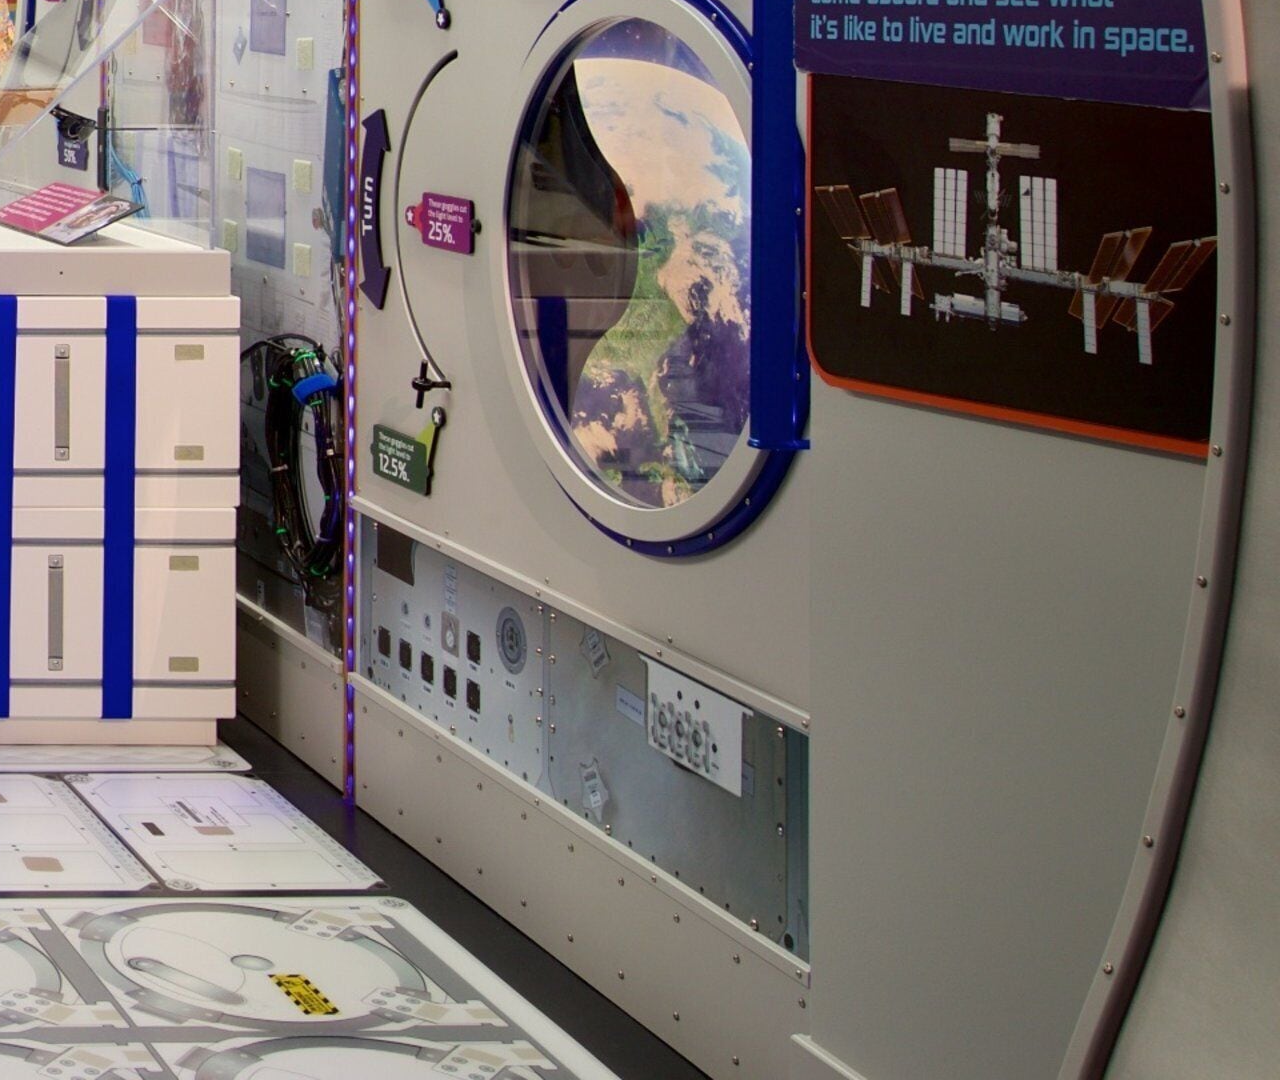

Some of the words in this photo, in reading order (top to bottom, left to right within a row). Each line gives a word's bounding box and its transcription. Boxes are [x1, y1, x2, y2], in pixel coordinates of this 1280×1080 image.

[843, 15, 877, 41] like
[883, 16, 903, 42] to
[909, 16, 947, 44] live
[953, 18, 996, 45] and
[1003, 19, 1065, 49] work
[1073, 19, 1095, 49] in
[1104, 26, 1195, 57] space.
[361, 175, 374, 237] Turn
[428, 220, 456, 244] 25%.
